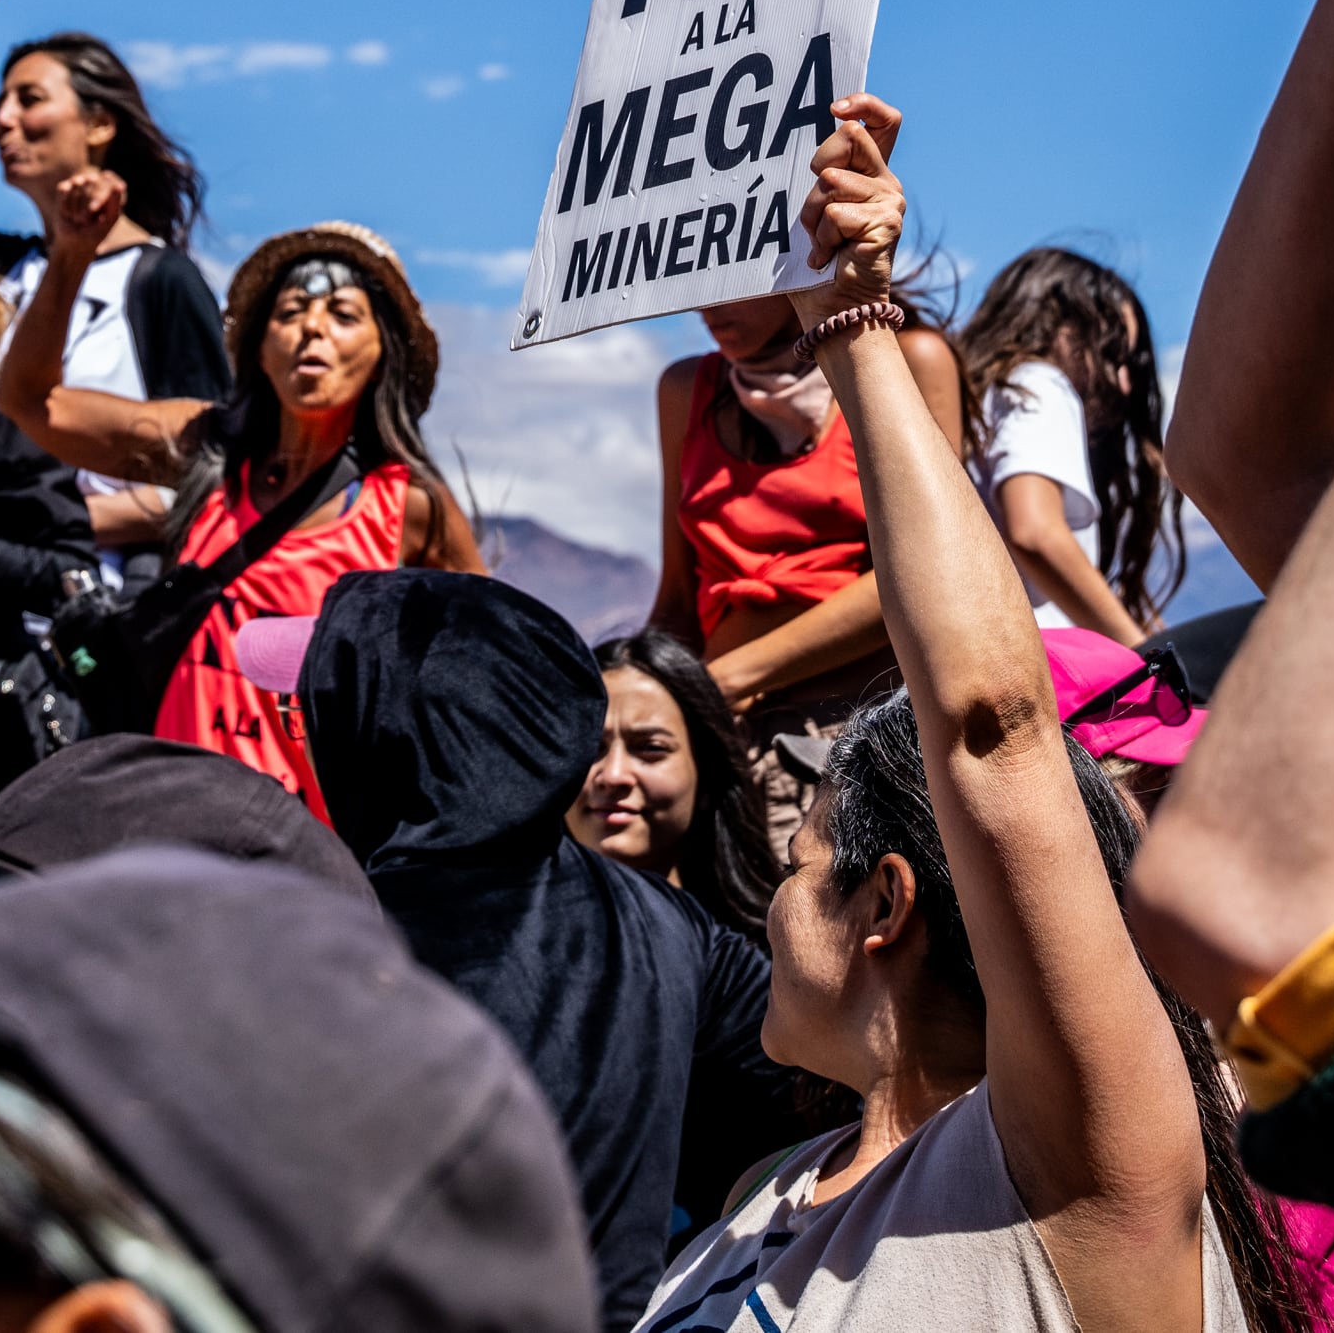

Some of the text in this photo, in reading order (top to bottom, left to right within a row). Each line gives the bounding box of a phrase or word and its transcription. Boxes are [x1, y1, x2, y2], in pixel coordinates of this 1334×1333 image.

[680, 11, 704, 55] A
[557, 32, 837, 214] MEGA
[561, 174, 791, 303] MINERÍA
[212, 706, 227, 733] A
